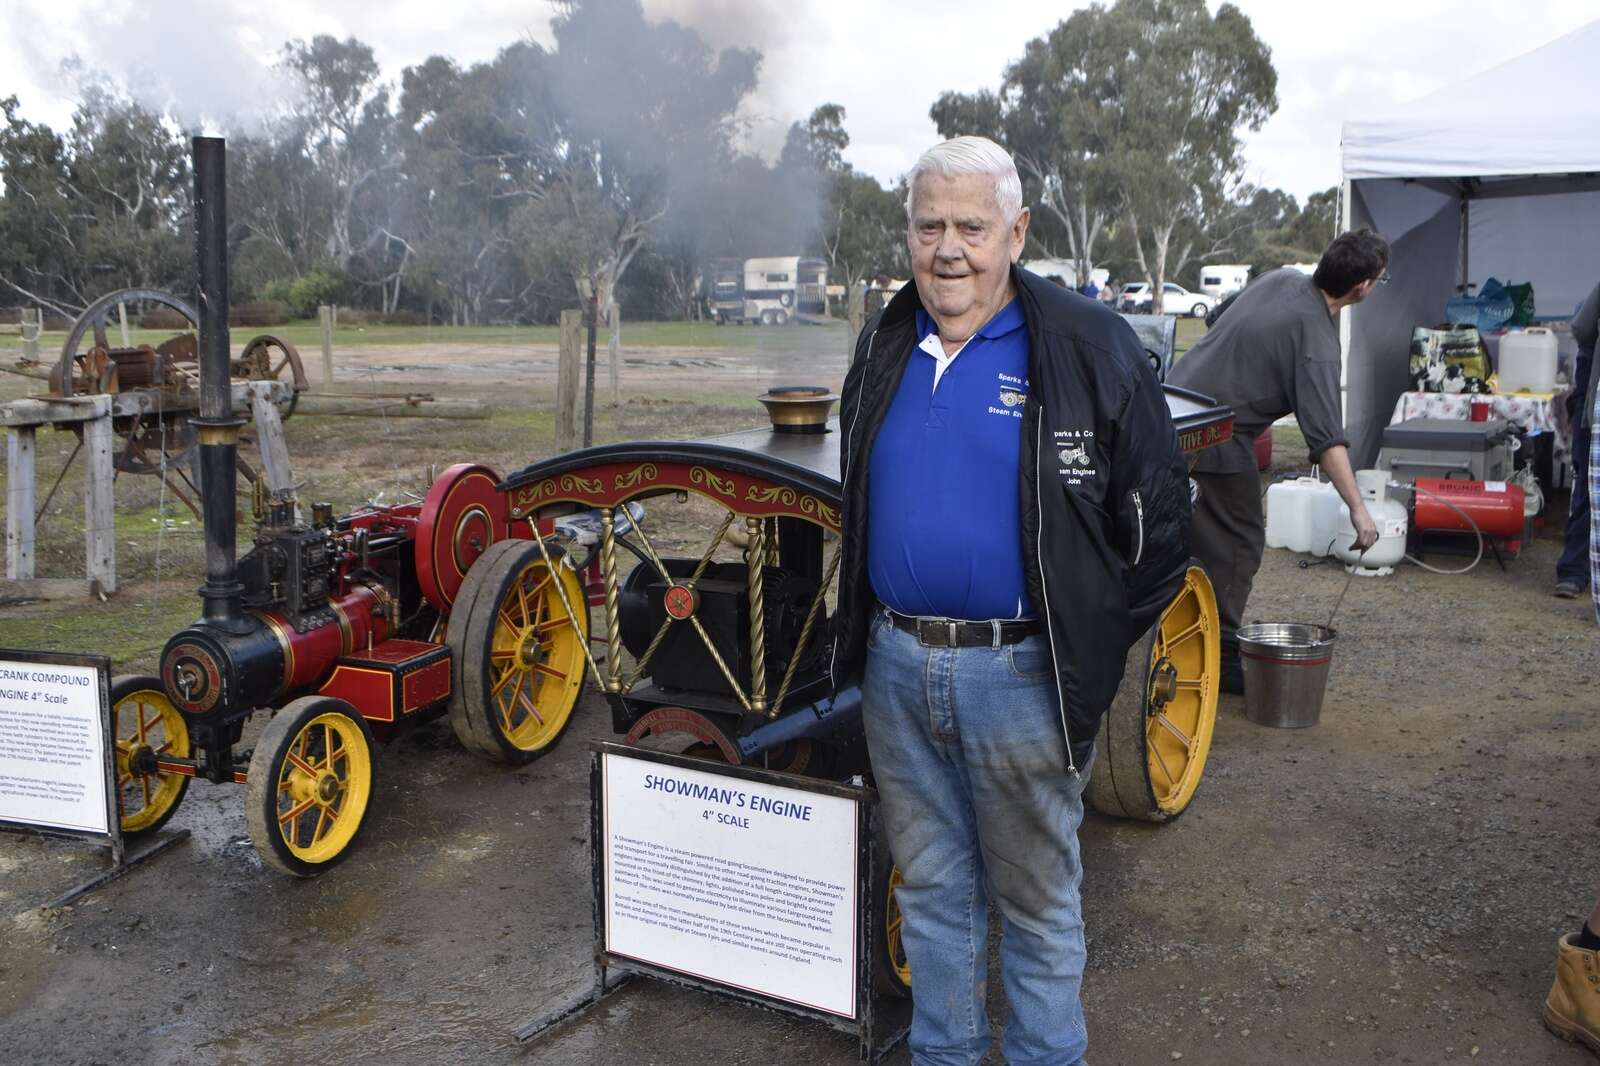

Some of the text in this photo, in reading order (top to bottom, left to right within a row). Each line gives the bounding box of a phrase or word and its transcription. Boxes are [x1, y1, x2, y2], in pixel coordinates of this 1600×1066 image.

[998, 372, 1022, 384] Sparks
[988, 406, 1010, 416] Steam
[1075, 430, 1080, 438] &
[1084, 430, 1094, 438] Co
[1072, 468, 1096, 477] Engines
[32, 672, 90, 687] COMPOUND
[44, 693, 68, 705] Scale
[644, 774, 812, 822] SHOWMAN'S ENGINE
[702, 810, 750, 829] 4" SCALE
